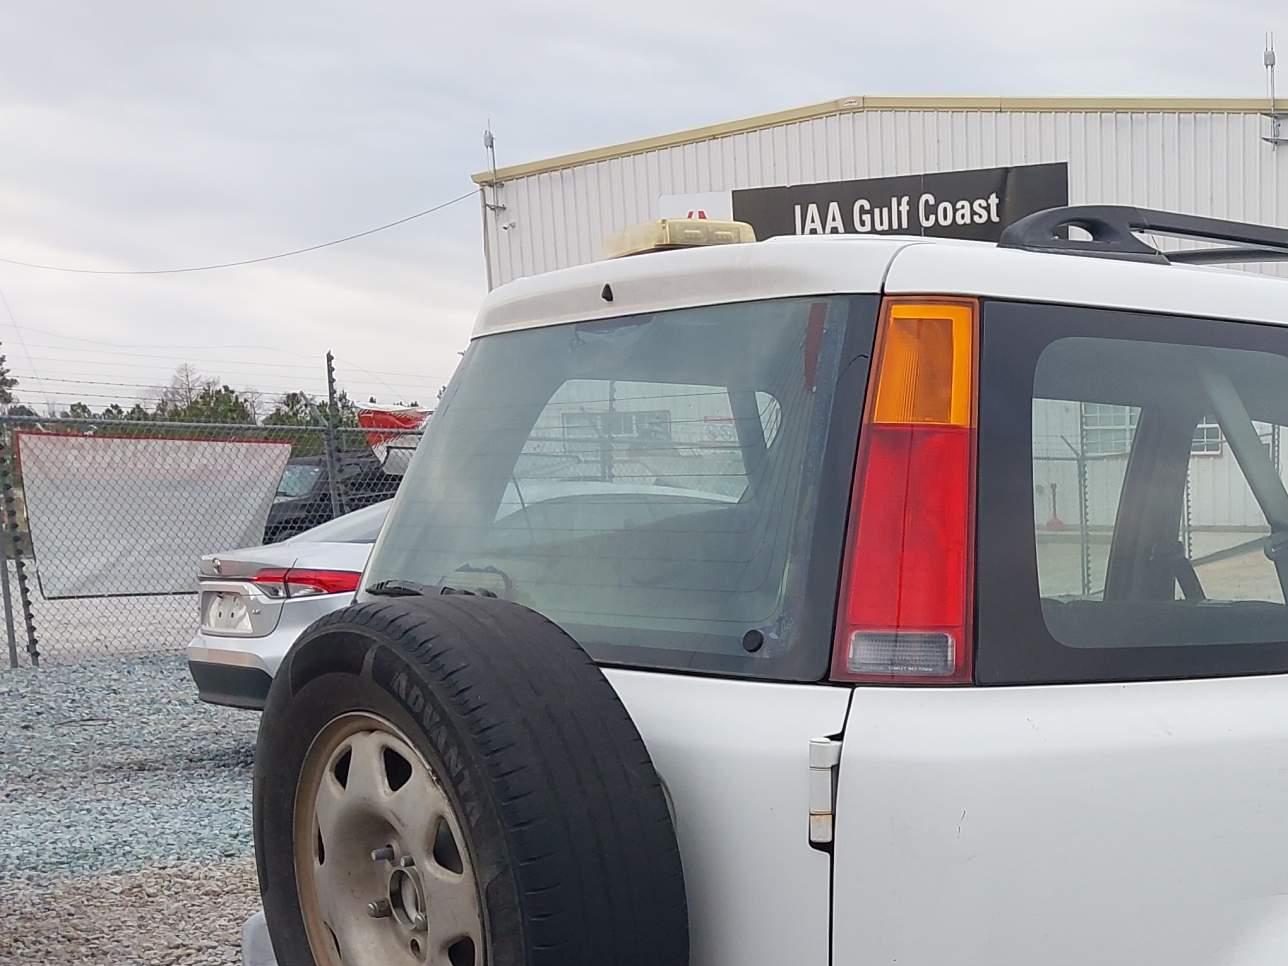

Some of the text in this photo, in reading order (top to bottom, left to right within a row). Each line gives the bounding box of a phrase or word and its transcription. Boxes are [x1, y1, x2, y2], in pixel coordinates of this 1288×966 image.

[794, 192, 1000, 235] IAA Gulf Coast
